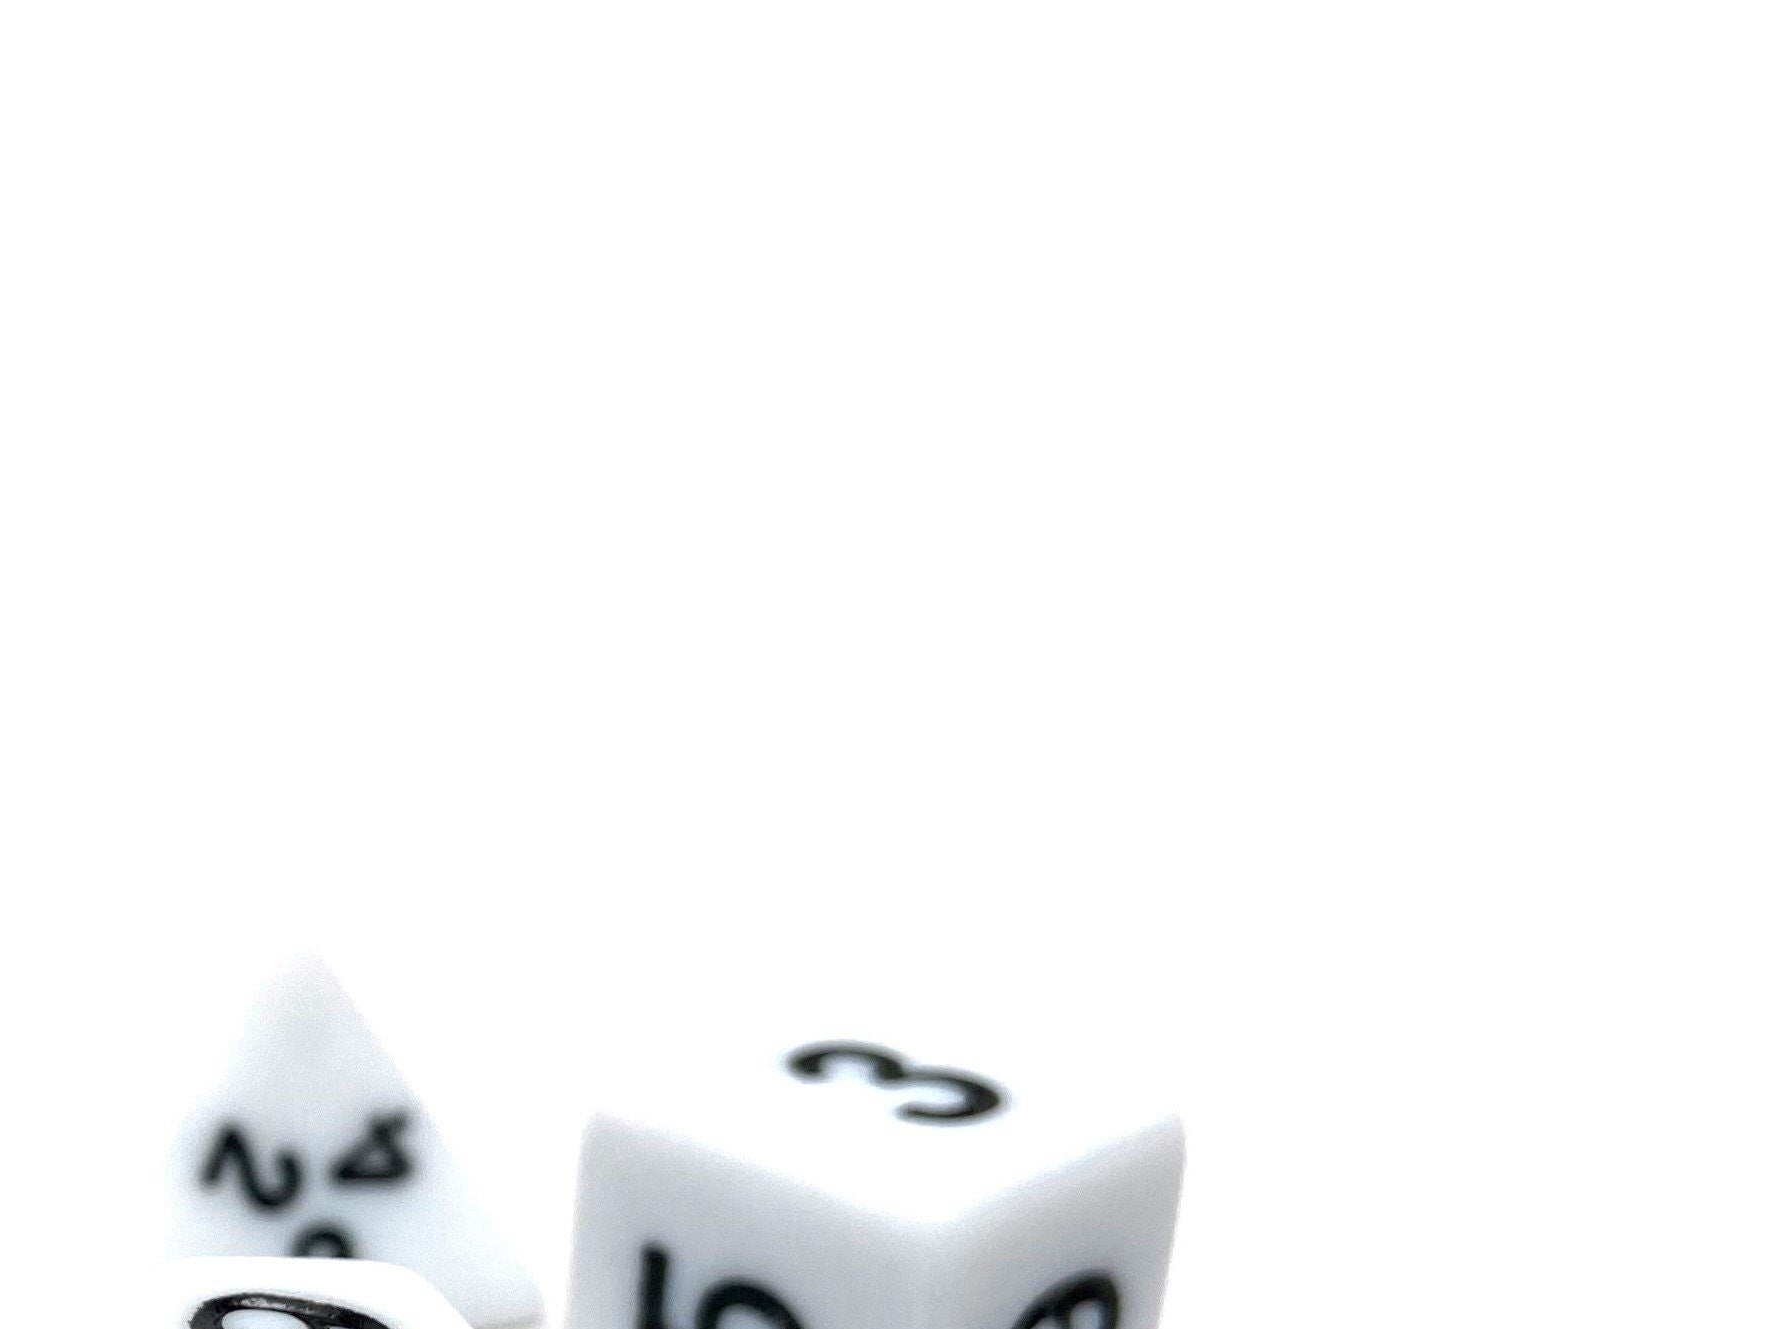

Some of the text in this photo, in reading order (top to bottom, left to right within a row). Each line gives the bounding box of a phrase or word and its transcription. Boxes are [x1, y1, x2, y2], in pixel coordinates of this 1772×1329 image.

[786, 1043, 1003, 1123] 3
[200, 1121, 309, 1217] 2
[328, 1108, 415, 1190] 4
